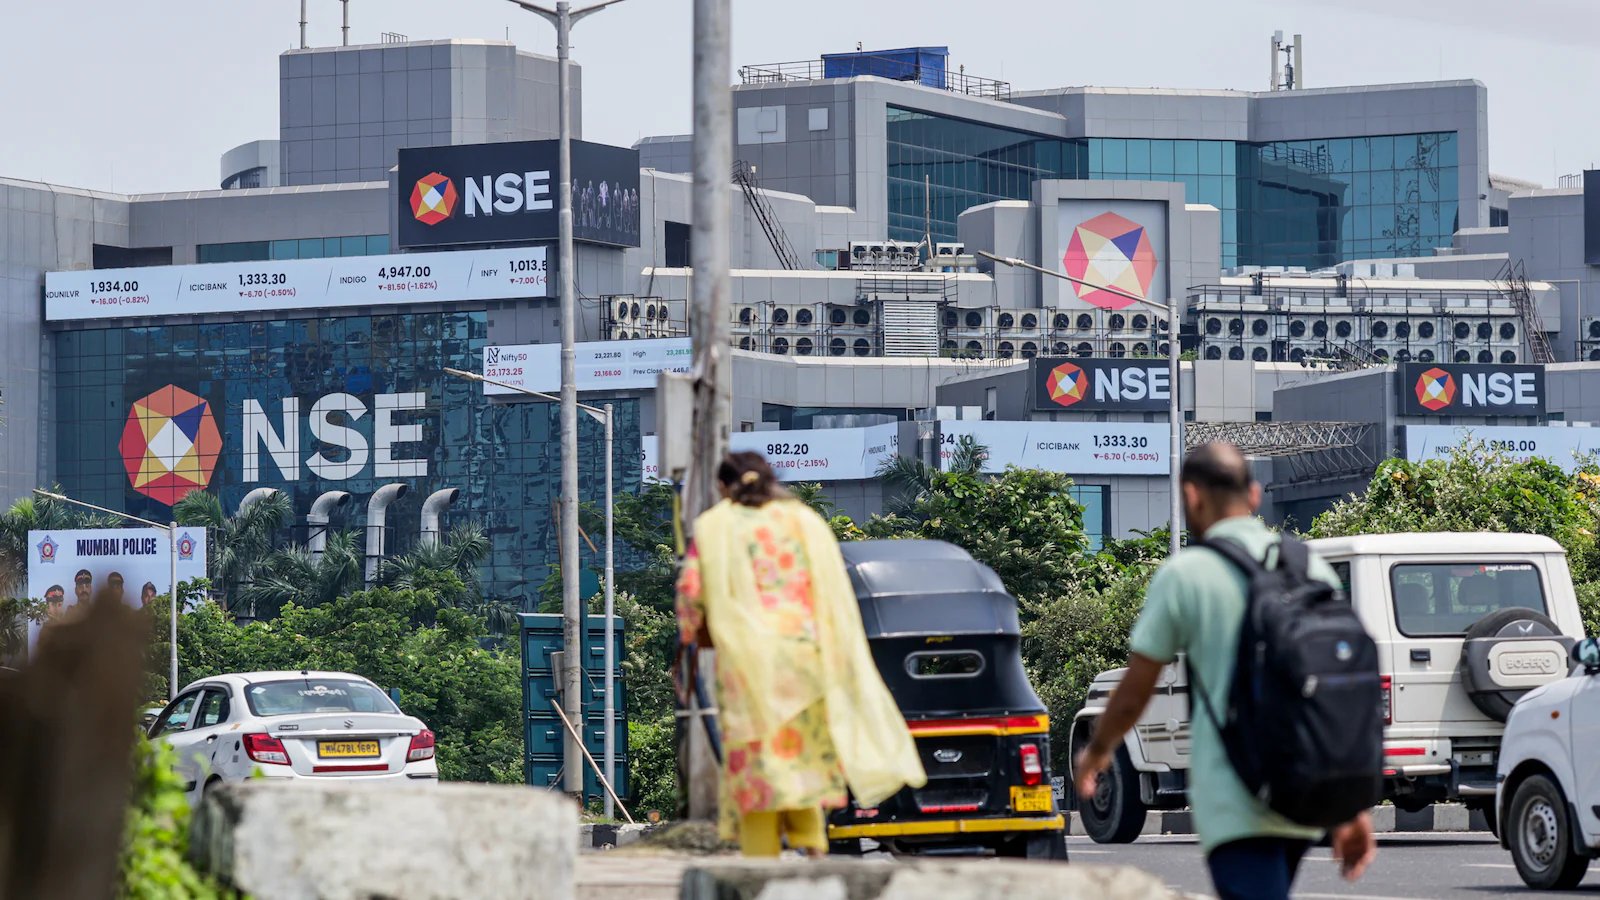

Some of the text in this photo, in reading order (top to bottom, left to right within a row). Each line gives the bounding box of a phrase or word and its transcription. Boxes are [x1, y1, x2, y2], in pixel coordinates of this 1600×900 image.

[464, 171, 553, 217] NSE
[378, 266, 431, 279] 4,947.00
[238, 273, 287, 287] 1,333.30
[340, 276, 367, 284] INDIGO
[90, 281, 139, 294] 1,934.00
[189, 283, 228, 291] ICICIBANK
[633, 350, 646, 358] High
[486, 367, 523, 377] 23,173.25
[1094, 367, 1170, 402] NSE
[1462, 372, 1538, 407] NSE
[243, 392, 428, 482] NSE
[1093, 435, 1148, 448] 1,333.30
[766, 443, 810, 455] 982.20
[1036, 442, 1080, 450] ICICIBANK
[76, 538, 157, 556] MUMBAI POLICE
